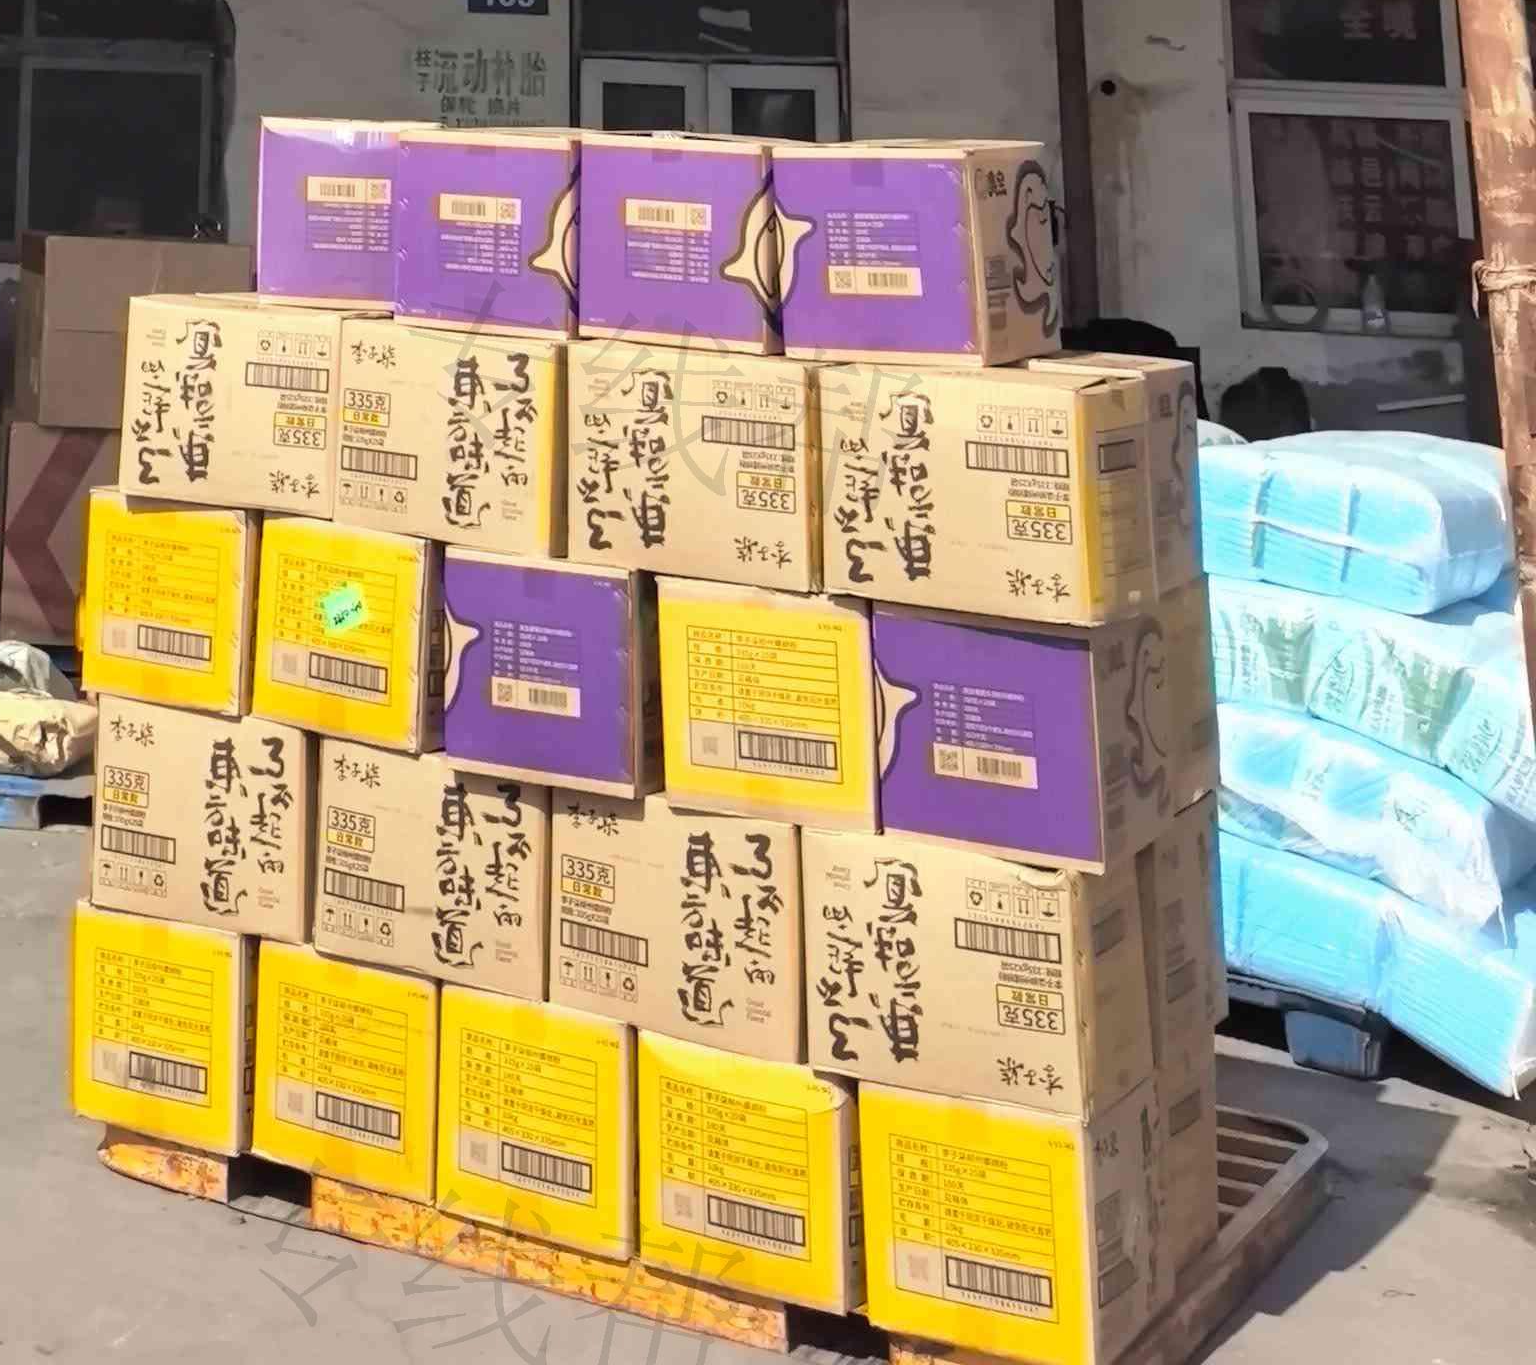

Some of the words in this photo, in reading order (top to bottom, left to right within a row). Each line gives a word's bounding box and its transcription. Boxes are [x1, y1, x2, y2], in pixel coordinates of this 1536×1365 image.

[347, 392, 387, 411] 335克
[277, 428, 322, 447] 335克
[740, 490, 791, 511] 335克
[1011, 519, 1066, 542] 335克
[106, 770, 146, 789] 335克
[329, 811, 372, 833] 335克
[563, 857, 611, 882] 335克
[999, 1005, 1059, 1032] 335克
